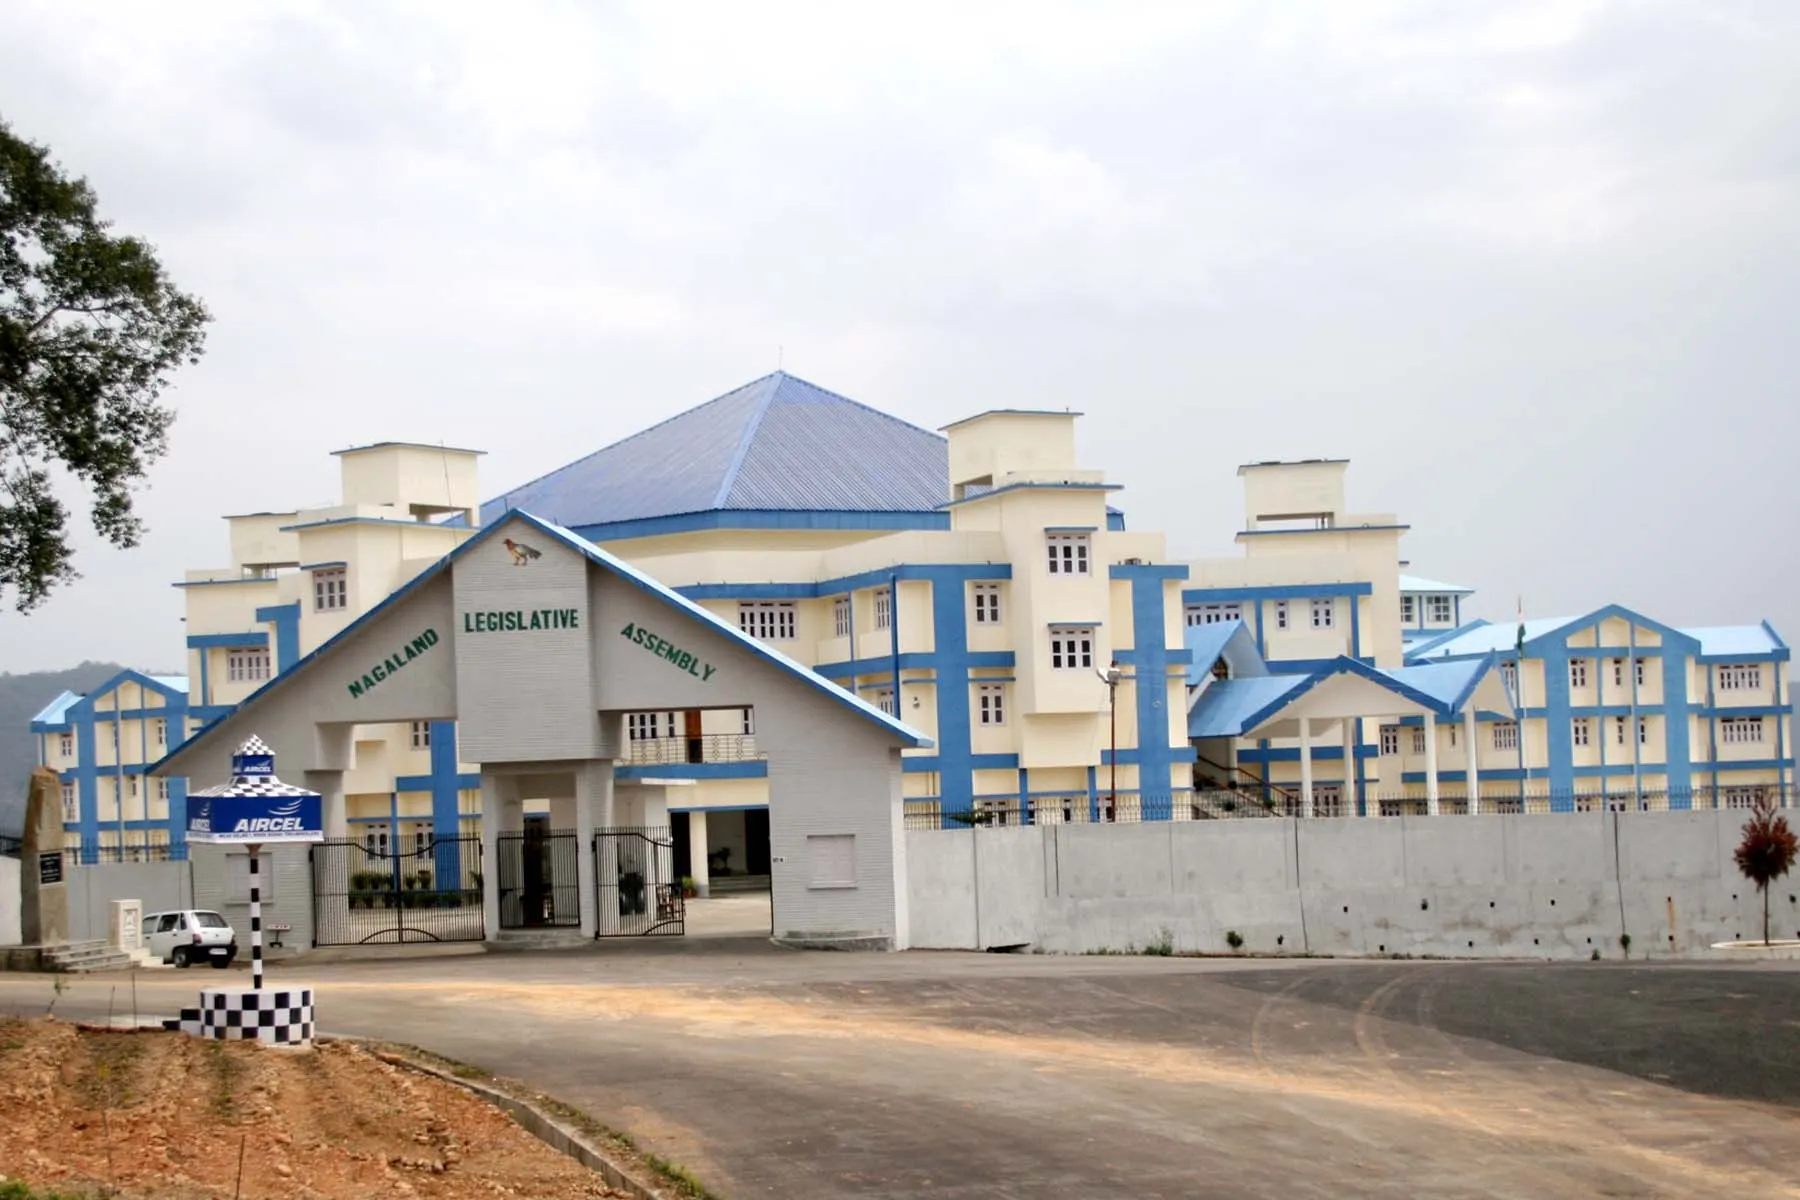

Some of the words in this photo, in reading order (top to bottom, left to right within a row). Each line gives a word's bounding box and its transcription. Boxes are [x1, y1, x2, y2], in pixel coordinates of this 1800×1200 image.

[347, 628, 440, 699] NAGALAND
[464, 609, 579, 633] LEGISLATIVE
[620, 622, 717, 682] ASSEMBLY
[233, 817, 305, 832] AIRCEL
